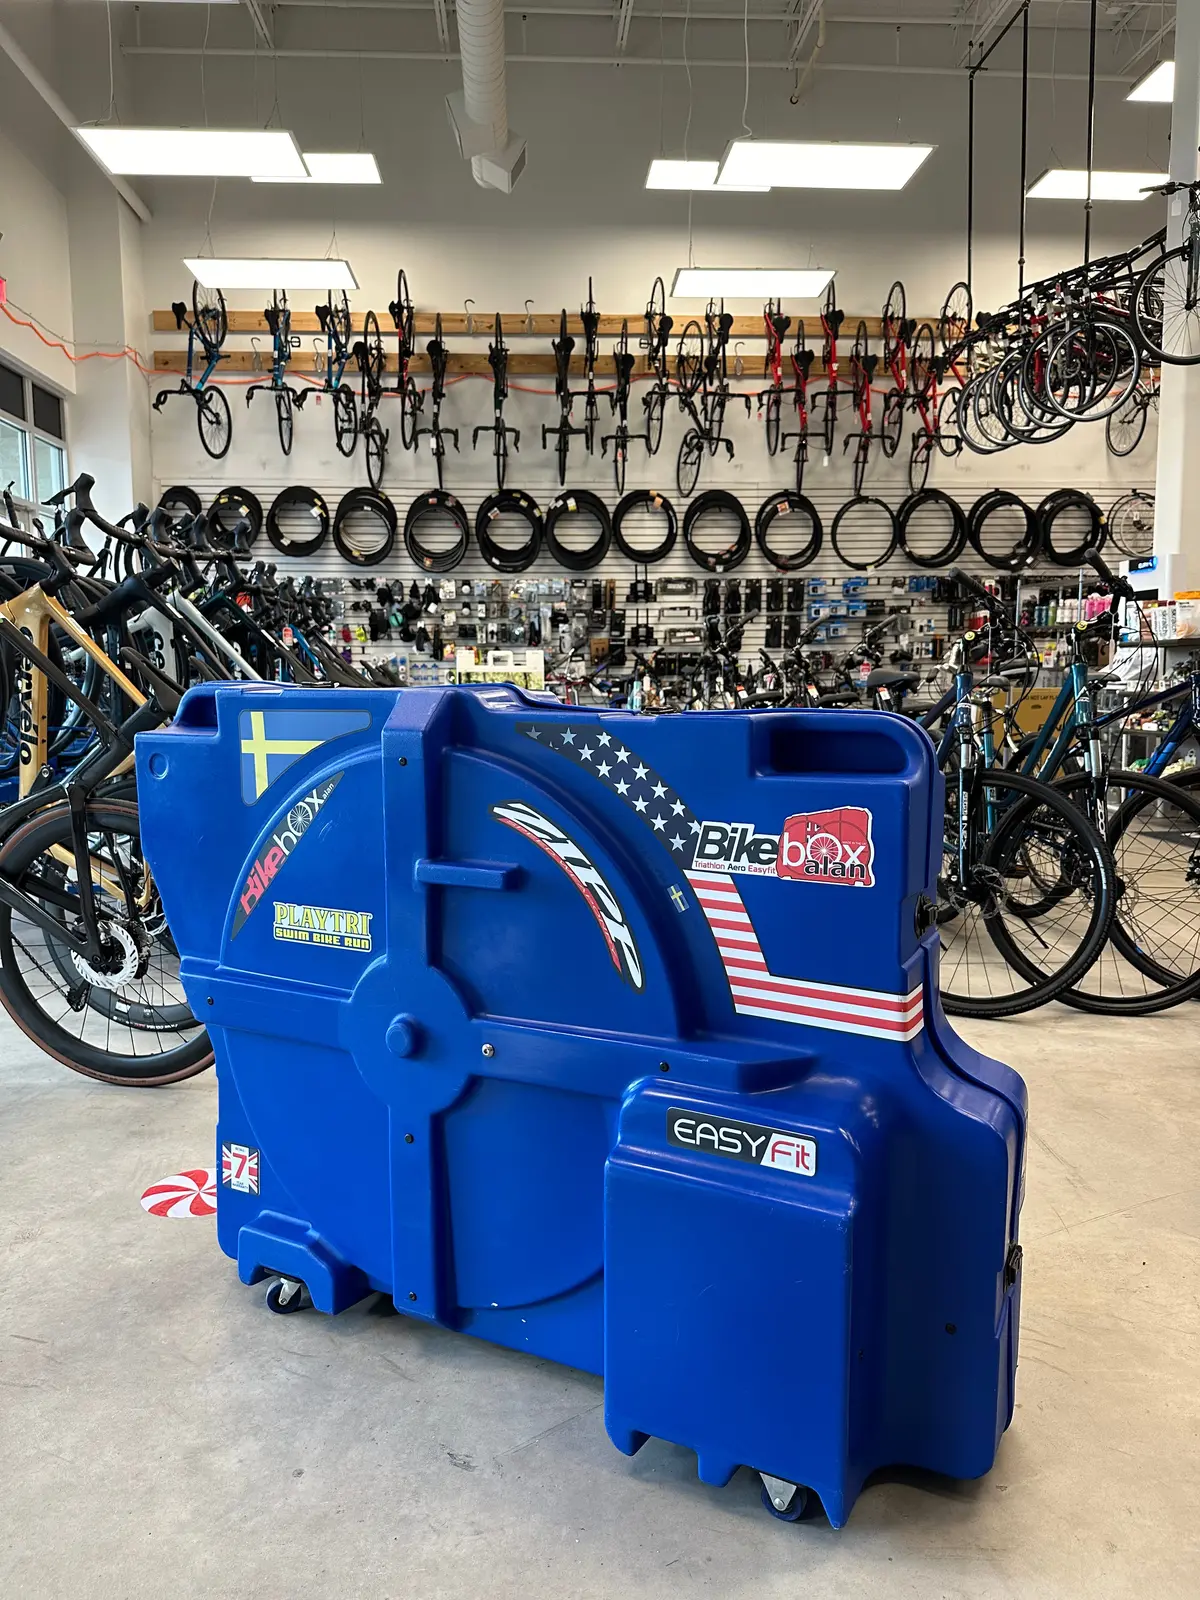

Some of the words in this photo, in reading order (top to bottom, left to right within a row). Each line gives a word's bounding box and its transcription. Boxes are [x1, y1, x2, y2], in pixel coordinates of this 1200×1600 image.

[695, 860, 725, 870] Triathlon
[727, 862, 746, 872] Aero
[748, 864, 776, 875] Easyfit
[804, 856, 866, 879] alan
[274, 902, 370, 936] PLAYTRI
[275, 927, 310, 941] SWIM
[312, 933, 341, 945] BIKE
[344, 938, 369, 949] RUN
[232, 1152, 247, 1179] 7
